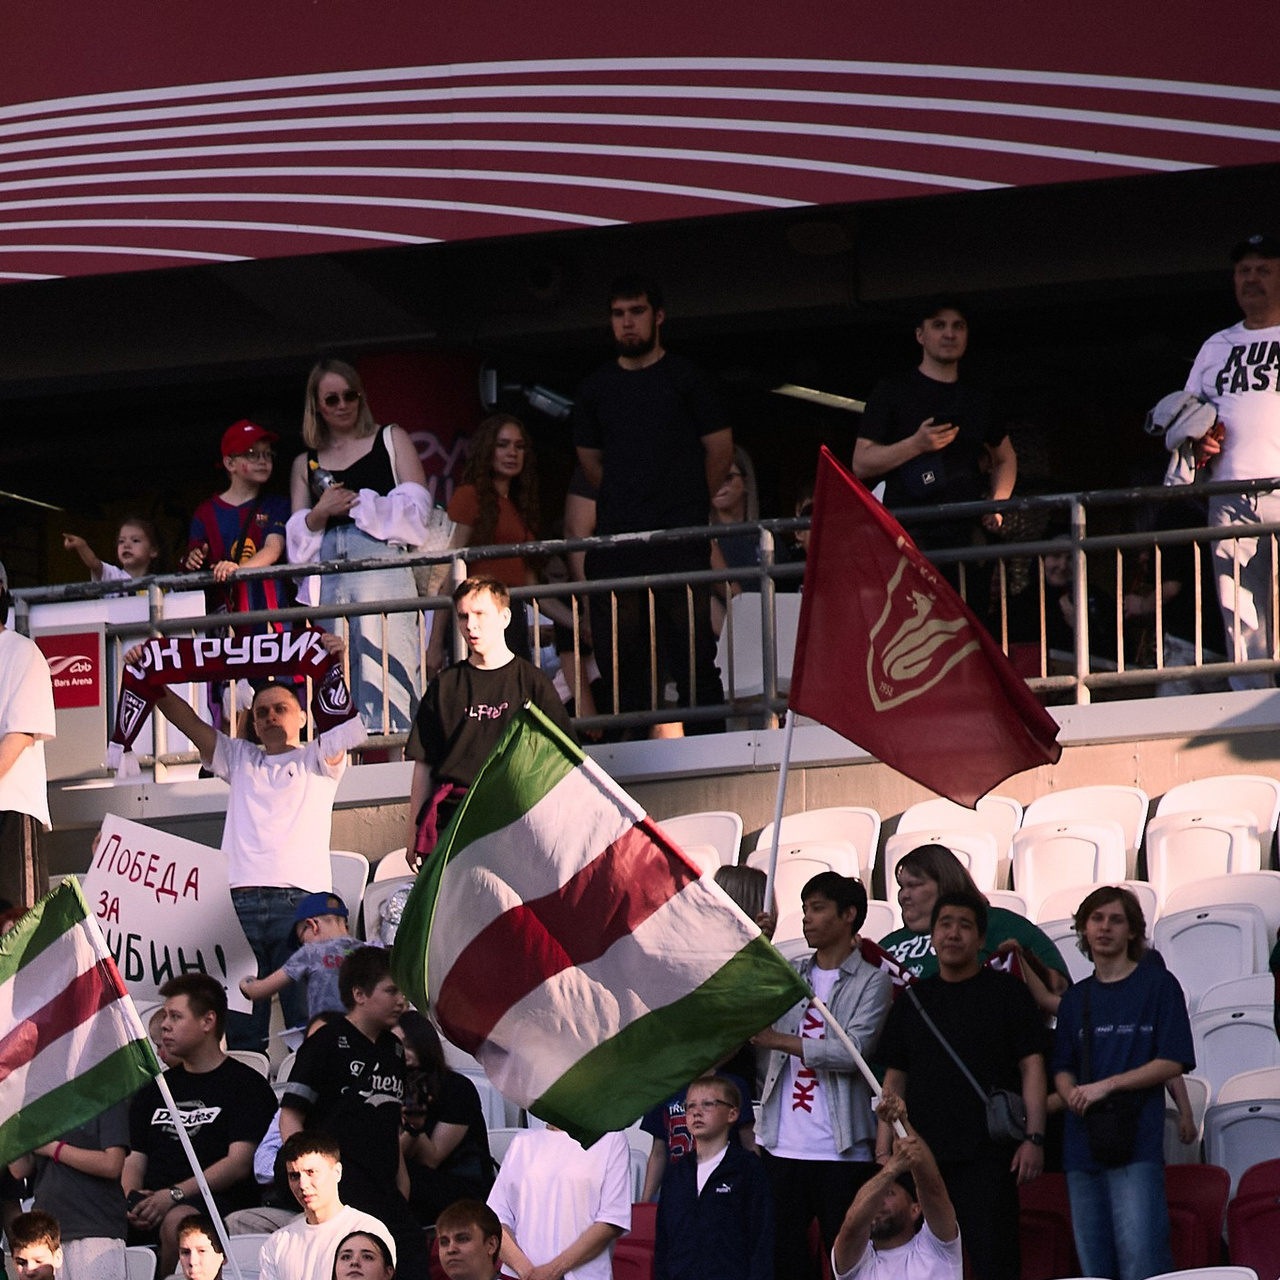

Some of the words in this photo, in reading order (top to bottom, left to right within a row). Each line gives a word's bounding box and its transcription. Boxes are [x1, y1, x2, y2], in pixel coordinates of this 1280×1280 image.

[192, 627, 329, 667] РУБИН
[72, 675, 93, 687] Arena
[97, 833, 199, 905] ПОБЕДА
[96, 889, 119, 924] ЗА
[105, 927, 229, 991] УБИН!
[154, 1109, 215, 1125] Dckies
